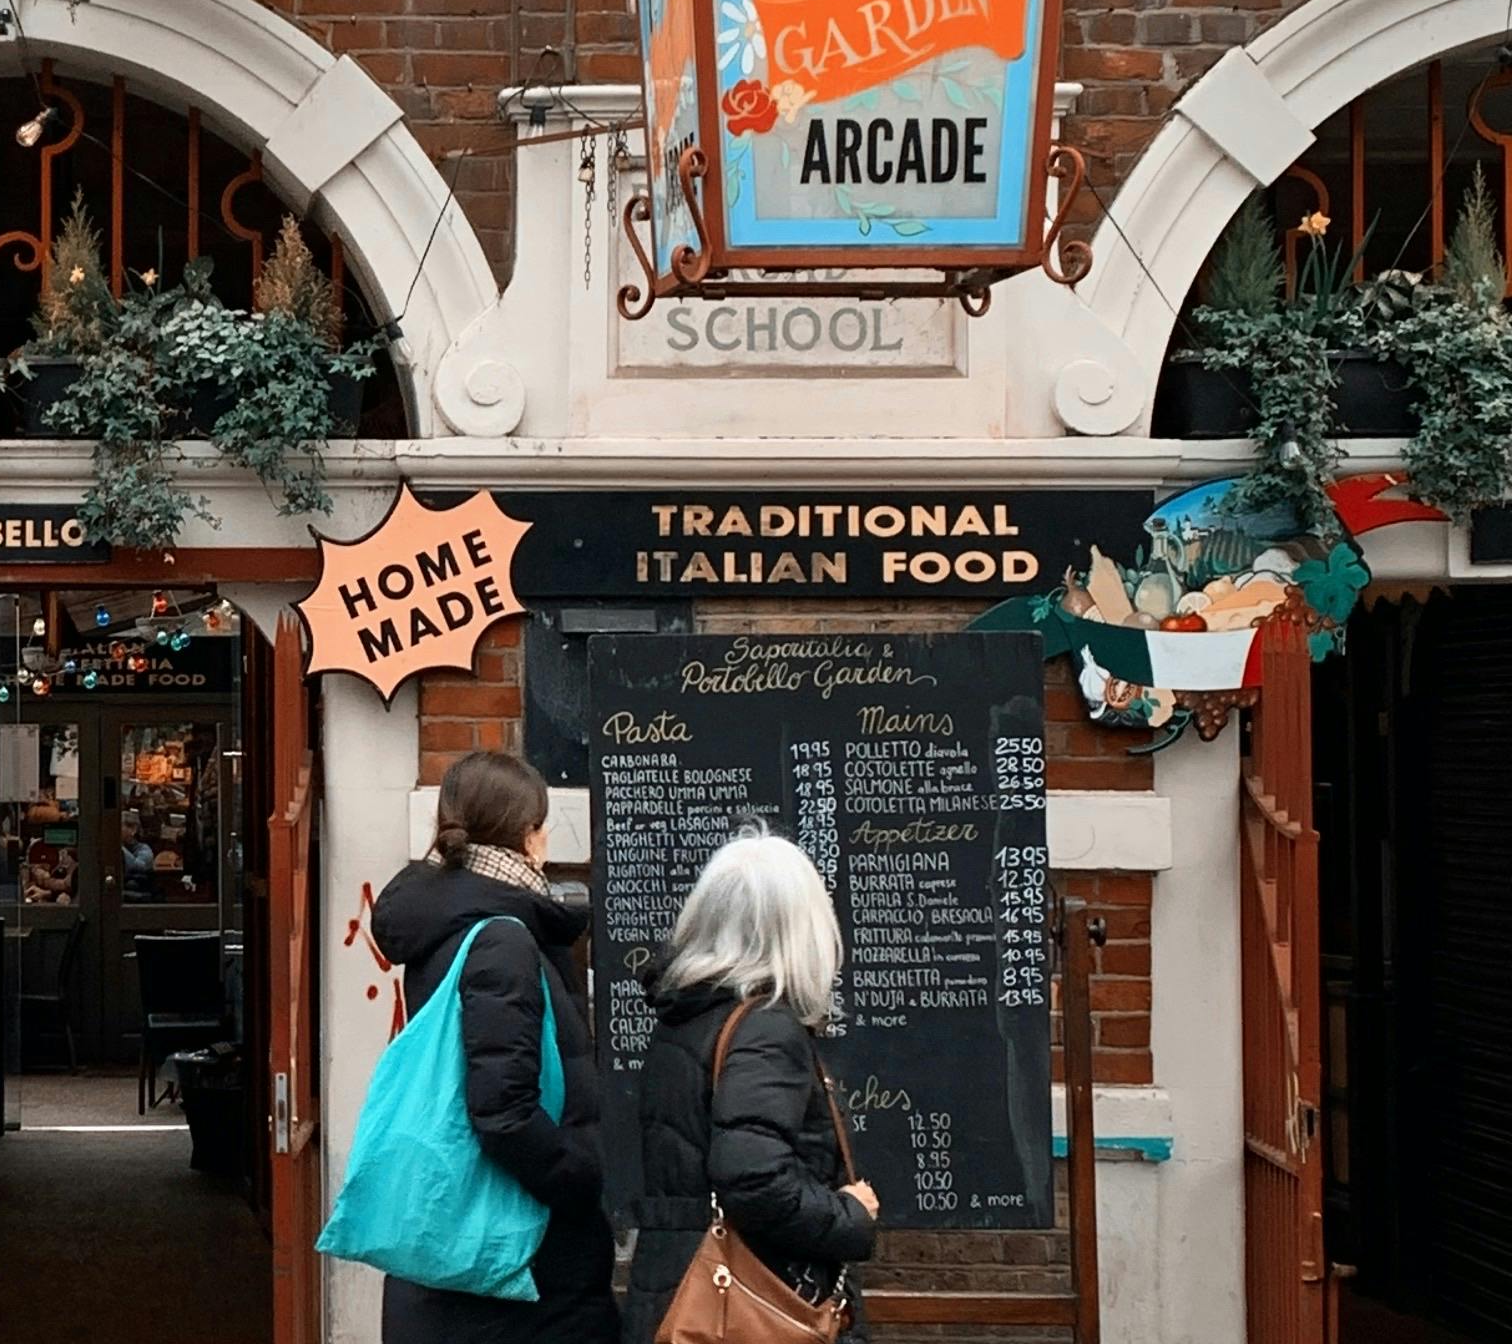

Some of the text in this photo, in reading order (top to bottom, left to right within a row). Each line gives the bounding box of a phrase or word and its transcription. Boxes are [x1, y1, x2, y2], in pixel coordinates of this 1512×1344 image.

[800, 117, 987, 185] ARCADE
[666, 306, 904, 353] SCHOOL
[652, 504, 1019, 538] TRADITIONAL
[338, 529, 494, 619] HOME
[636, 550, 1039, 584] ITALIAN FOOD
[356, 577, 506, 665] MADE
[881, 643, 894, 659] &
[149, 673, 206, 686] FOOD
[680, 659, 938, 699] Portobello Garden
[602, 709, 694, 745] Pasta
[856, 704, 954, 736] Mains
[845, 740, 969, 760] POLLETTO diavola
[601, 753, 678, 769] CARBONARA
[844, 760, 936, 779] COSTOLETTE
[602, 767, 753, 785] TAGLIATELLE BOLOGNESE
[605, 785, 665, 801] PACCHERO
[844, 778, 913, 797] SALMONE
[605, 800, 684, 816] PAPPARDELLE
[845, 794, 999, 815] COTOLETTA MILANESE
[606, 816, 633, 832] Beef
[670, 815, 730, 832] LASAGNA
[606, 831, 675, 848] SPAGHETTI
[849, 817, 979, 854] Appetizer
[673, 847, 712, 863] FRUTT
[848, 851, 950, 873] PARMIGIANA
[607, 863, 665, 879] RIGATONI
[606, 879, 668, 895] GNOCCHI
[849, 873, 915, 892] BURRATA
[851, 891, 902, 908] BUFALA
[606, 911, 676, 926] SPAGHETTI
[852, 907, 995, 926] CARPACCIO BRESAOLA
[607, 927, 650, 943] VEGAN
[853, 927, 914, 945] FRITTURA
[851, 946, 931, 964] MOZZARELLA
[853, 968, 941, 988] BRUSCHETTA
[919, 989, 988, 1008] BURRATA
[609, 1017, 659, 1035] CALZO
[855, 1013, 908, 1028] & more
[610, 1034, 652, 1053] CAPR
[969, 1193, 982, 1209] &
[987, 1193, 1025, 1209] more
